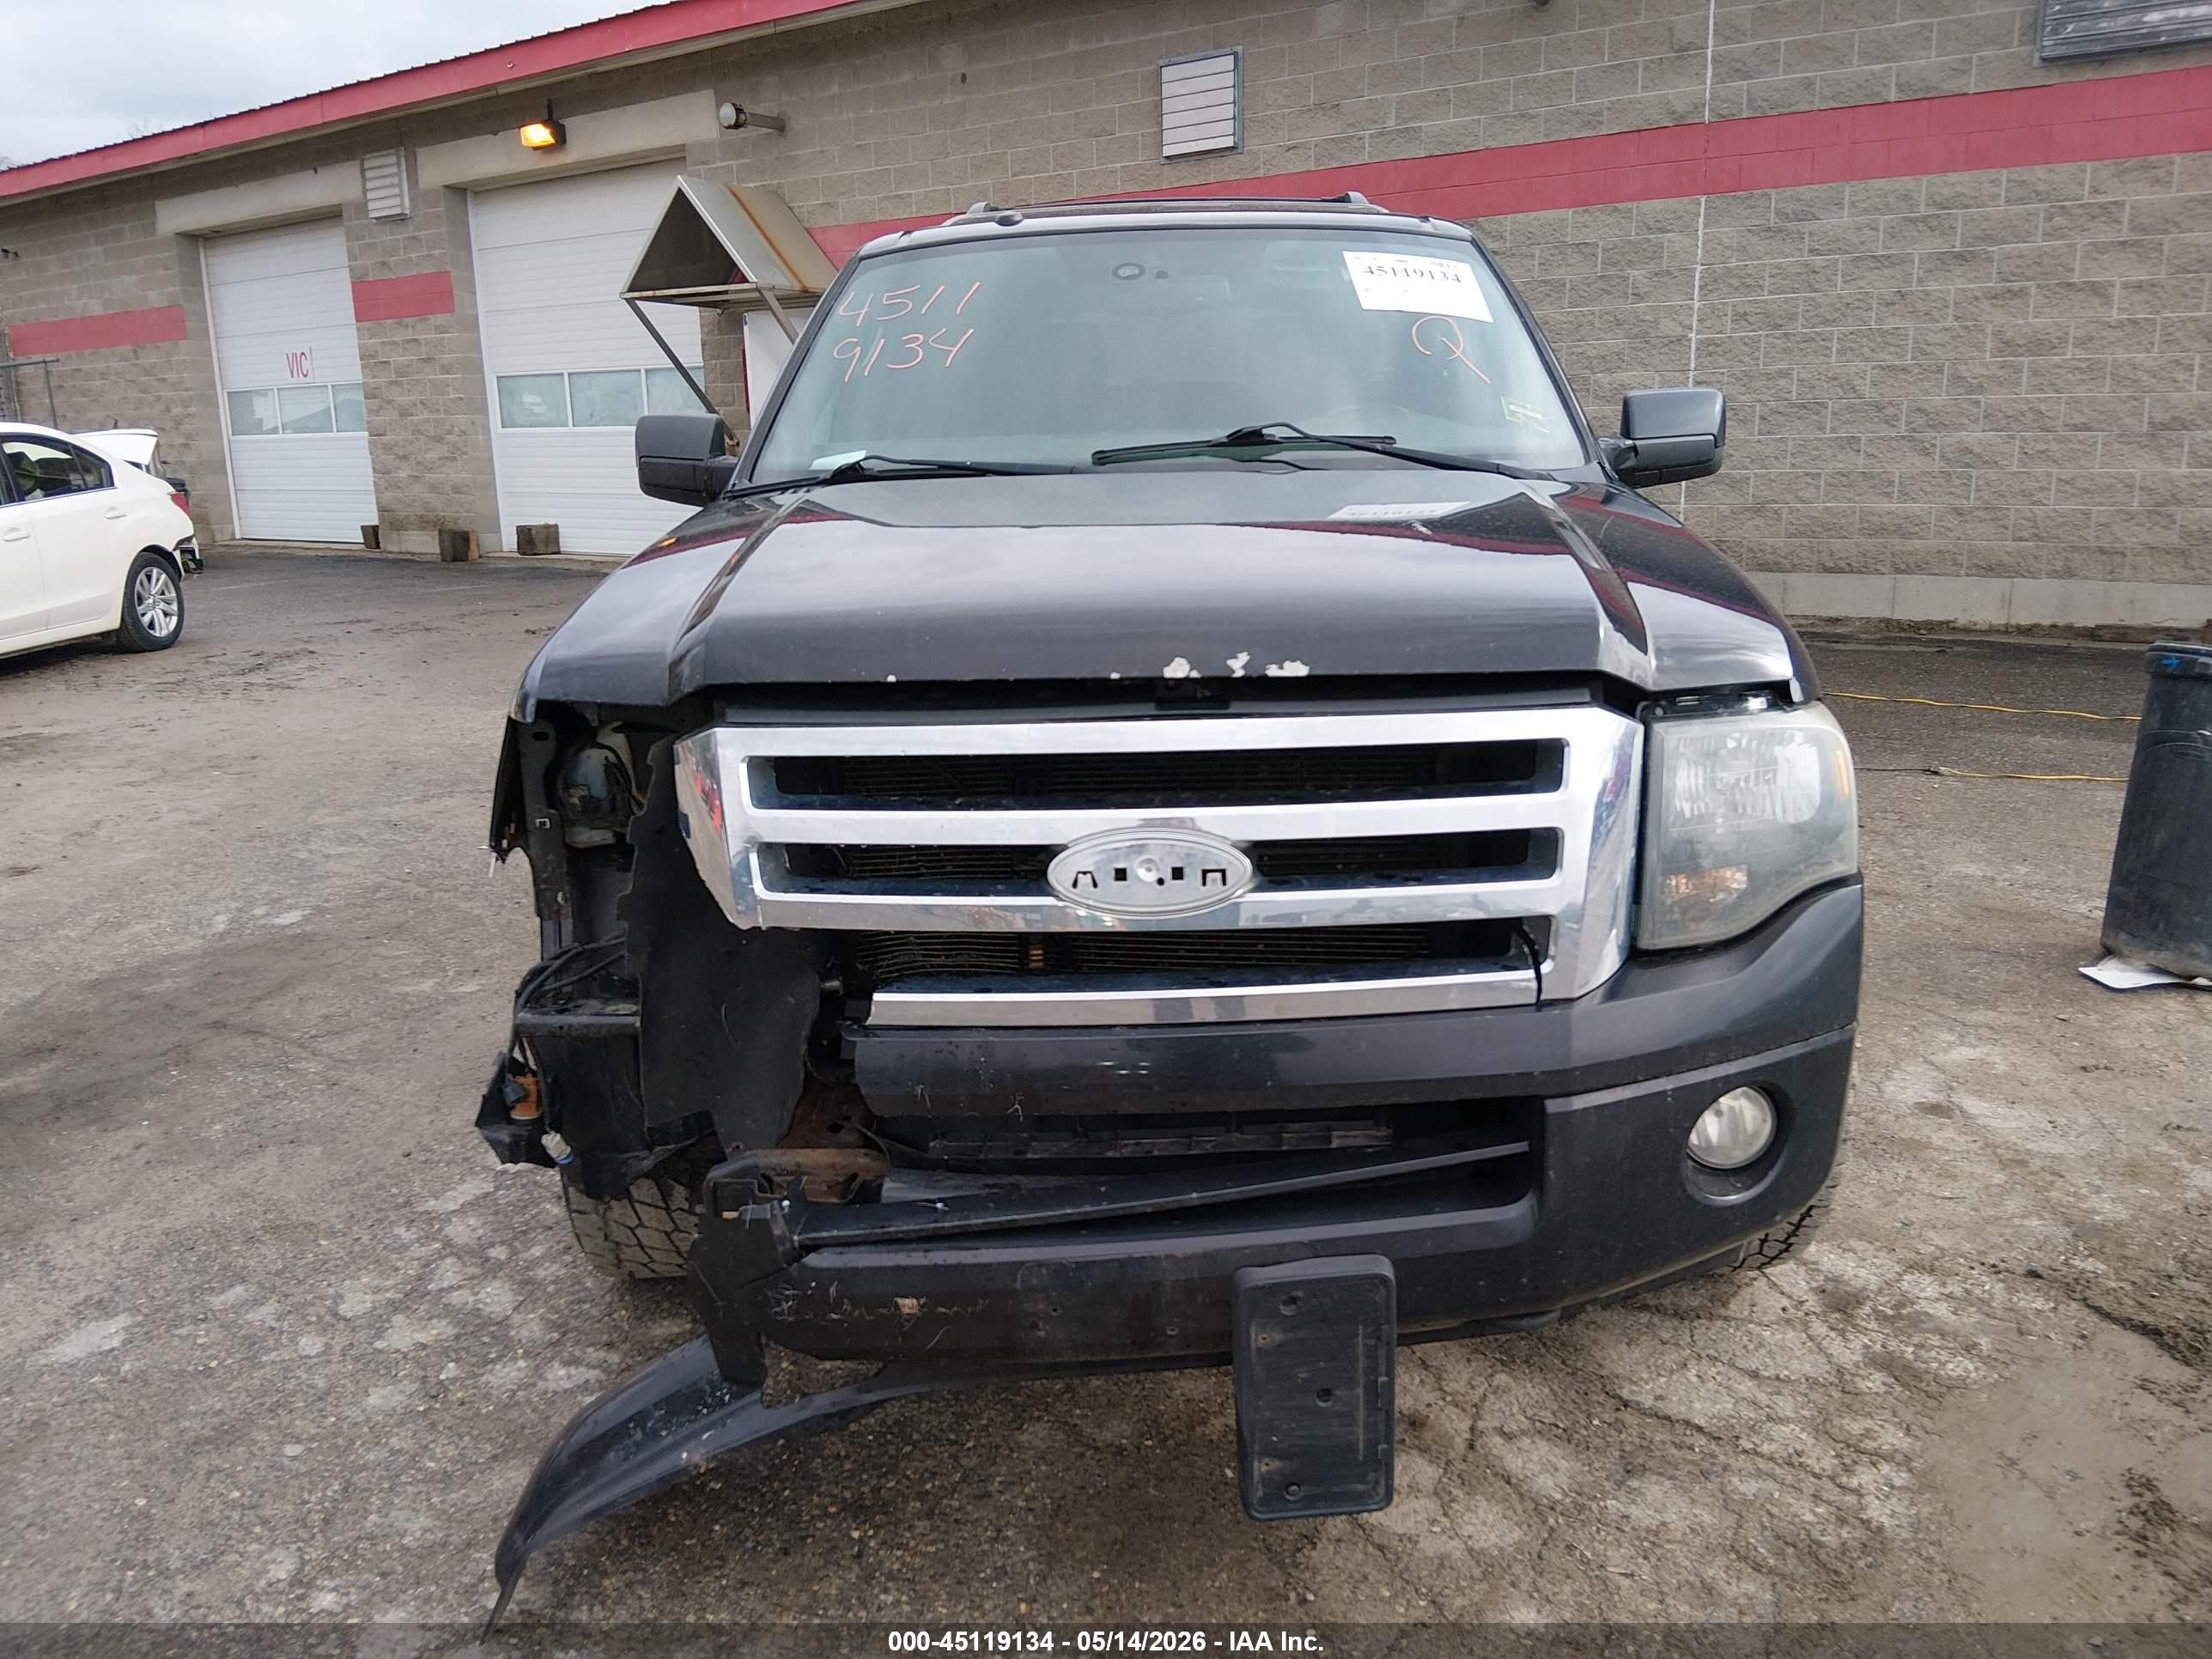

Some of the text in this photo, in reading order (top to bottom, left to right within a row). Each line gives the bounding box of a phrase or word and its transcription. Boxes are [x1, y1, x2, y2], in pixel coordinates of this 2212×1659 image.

[1363, 265, 1462, 284] 45119134
[837, 281, 981, 327] 4511
[832, 327, 975, 383] 9134
